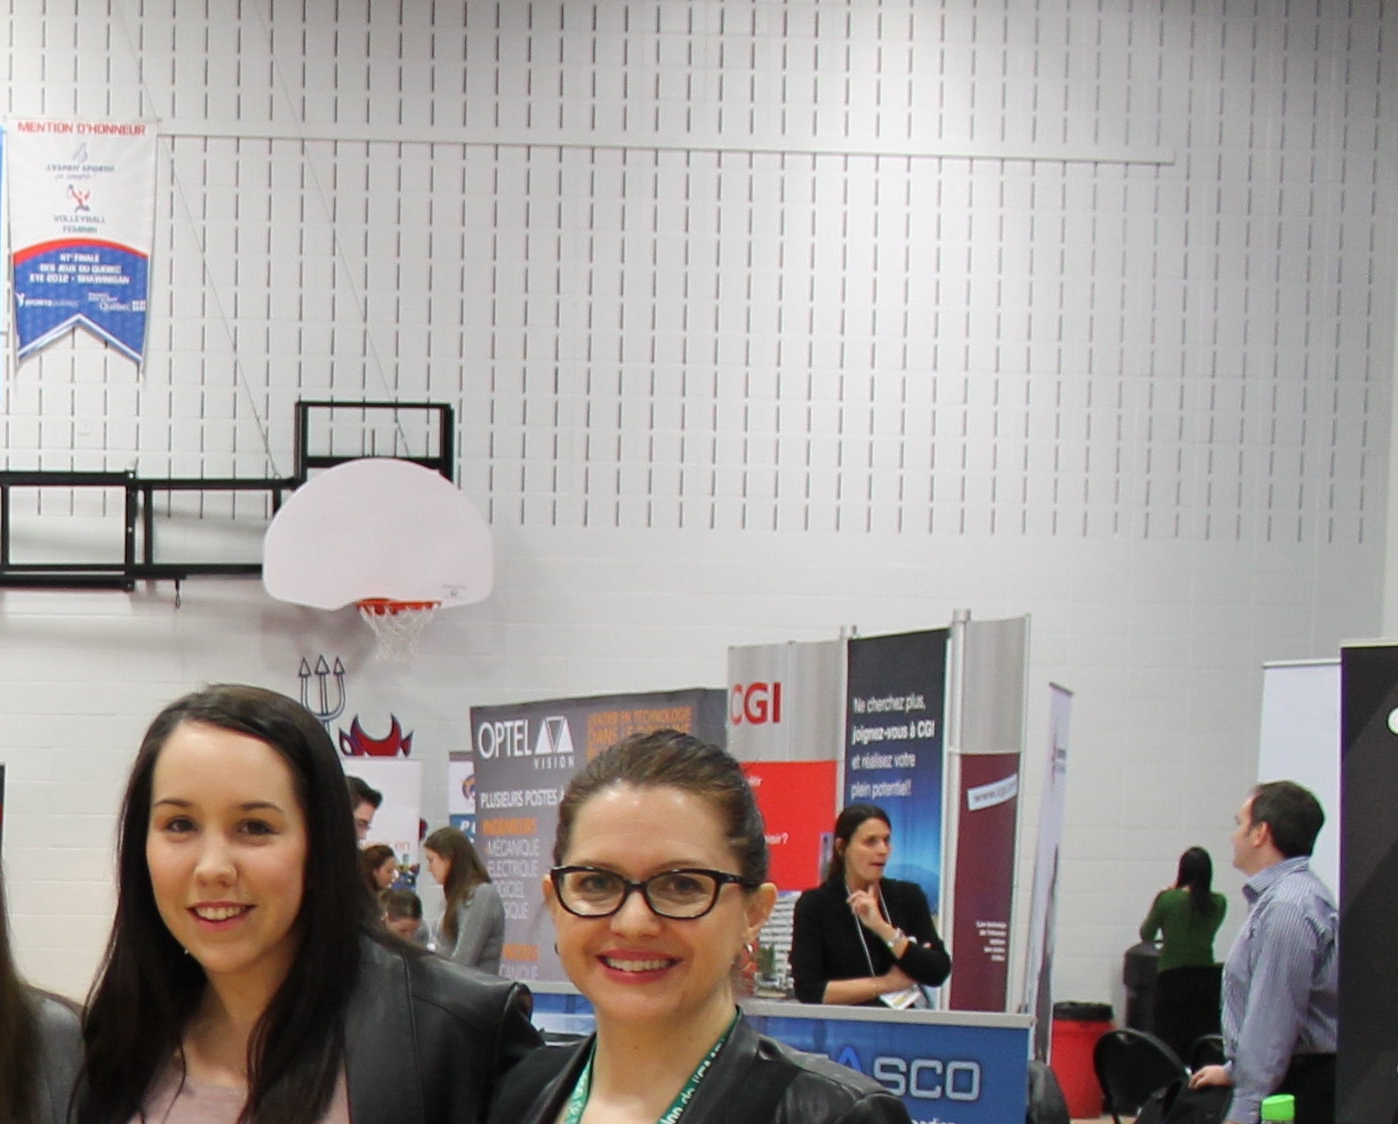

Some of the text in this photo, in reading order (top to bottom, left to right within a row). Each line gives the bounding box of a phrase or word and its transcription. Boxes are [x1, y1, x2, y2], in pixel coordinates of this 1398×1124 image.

[18, 122, 146, 136] MENTION D'HONNEUR
[731, 682, 782, 725] CGI
[854, 697, 865, 714] Ne
[867, 694, 905, 712] cherchez
[477, 720, 533, 759] OPTEL
[852, 720, 936, 745] joignez-vous à CGI
[534, 756, 575, 769] VISION
[852, 752, 916, 770] et réalisez votre
[851, 778, 912, 799] plein potentiel!
[481, 789, 558, 809] PLUSIEURS POSTES
